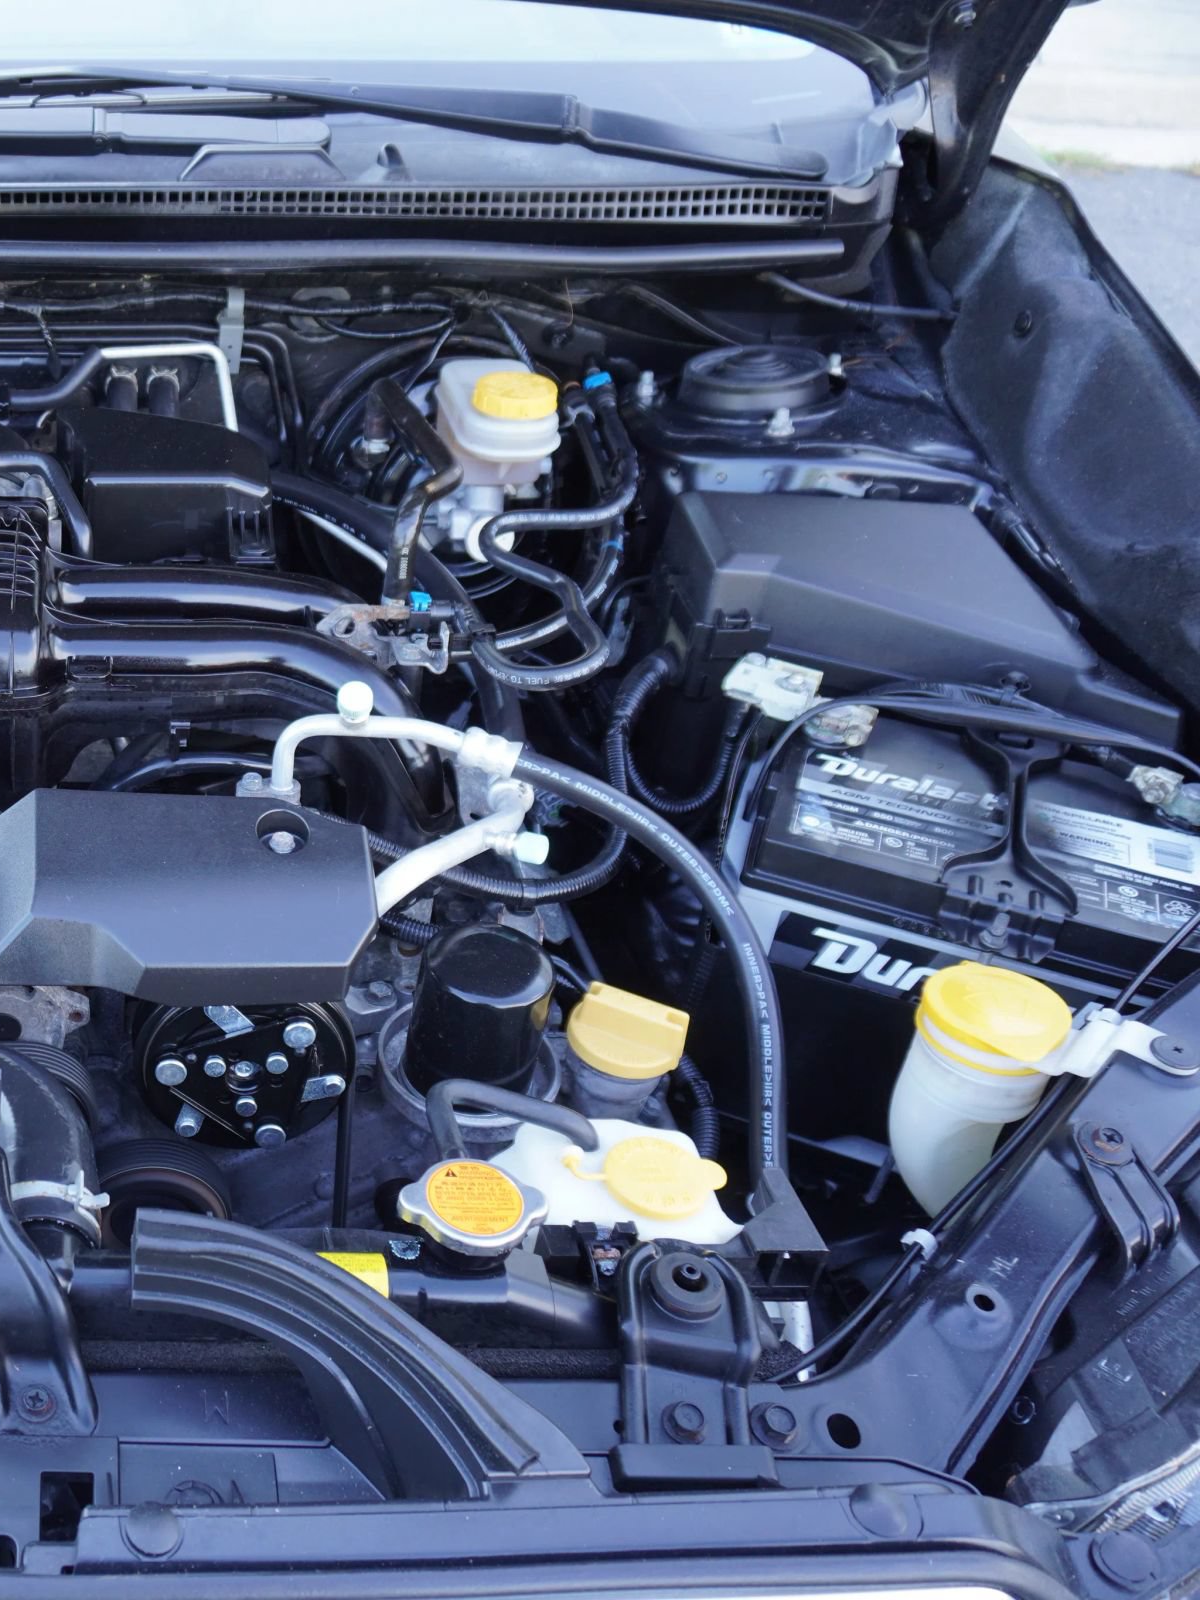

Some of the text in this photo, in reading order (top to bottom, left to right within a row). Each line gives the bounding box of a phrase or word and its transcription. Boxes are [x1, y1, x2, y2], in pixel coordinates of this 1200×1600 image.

[816, 752, 1000, 811] Duralast
[830, 788, 996, 831] AGM TECHNOLOGY
[661, 832, 735, 917] OUTER>EPDM<
[810, 926, 940, 992] Dur
[742, 943, 770, 1020] INNER>PA<
[763, 1111, 774, 1168] OUTER>E
[987, 1255, 1020, 1280] ML
